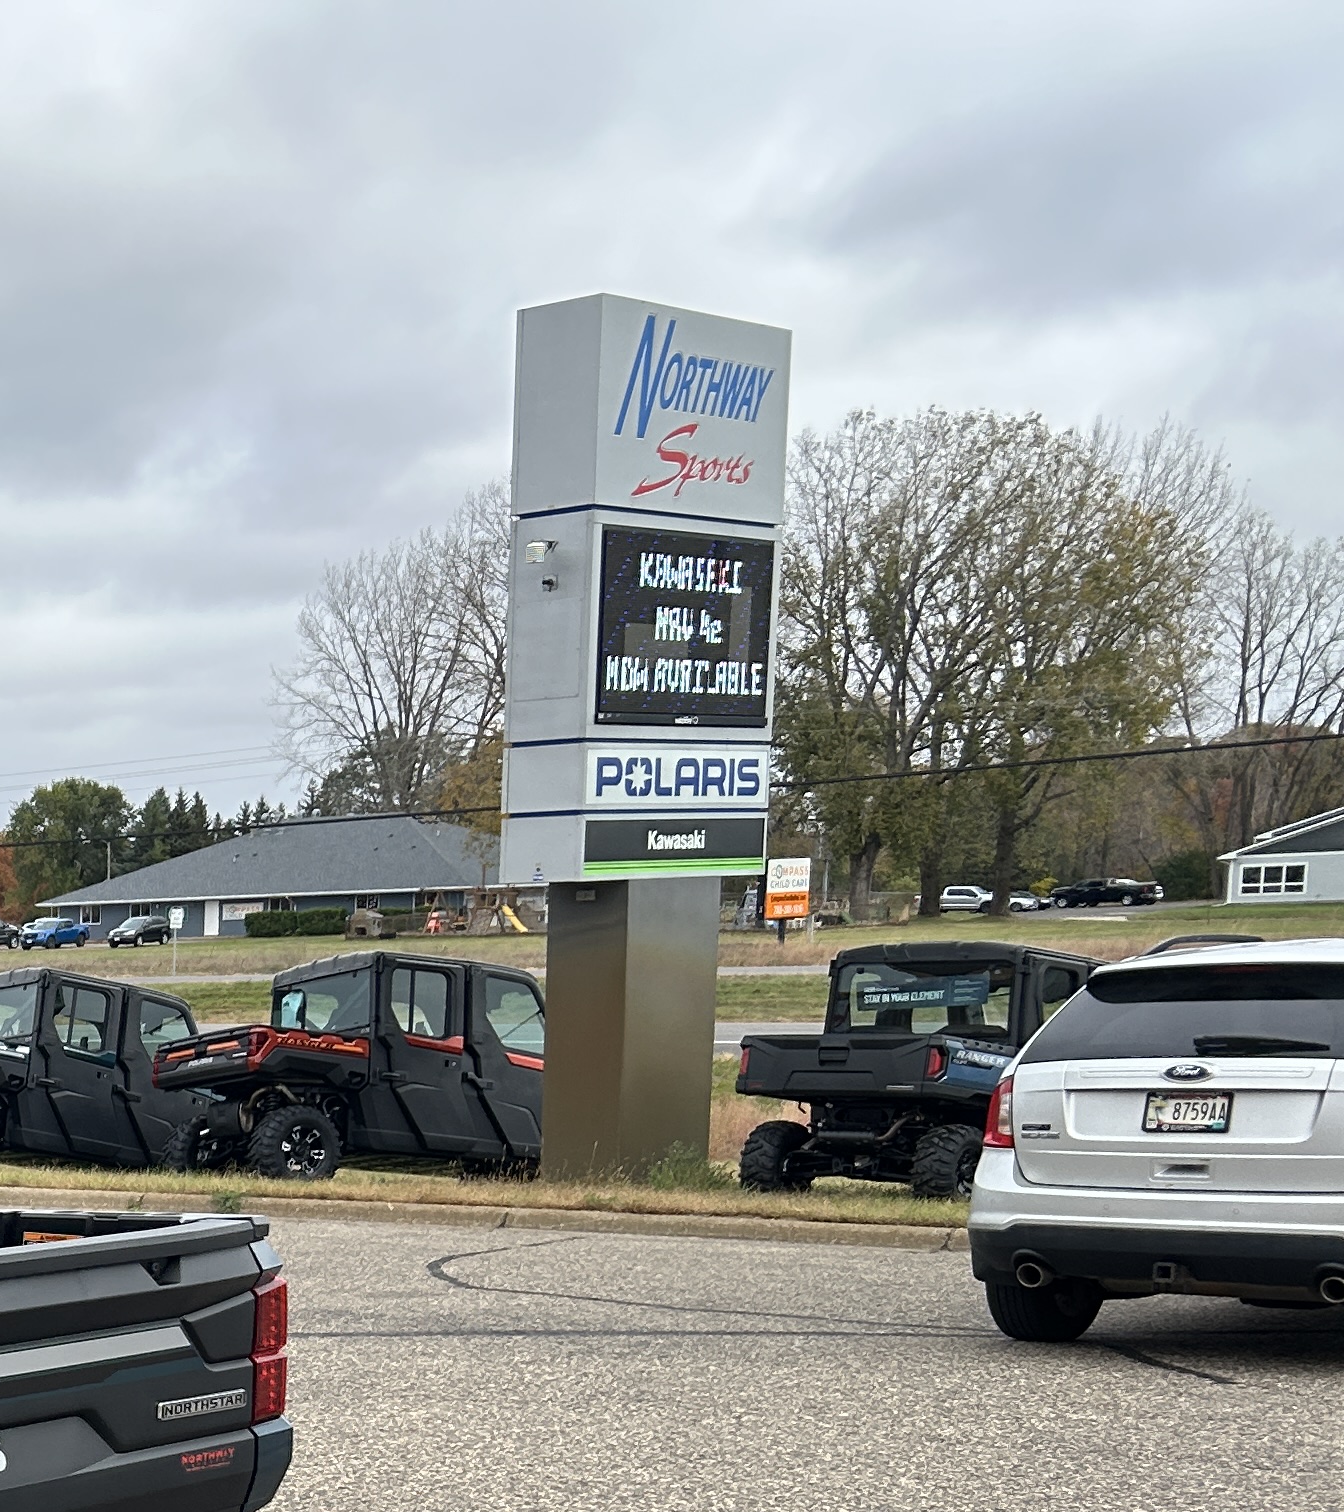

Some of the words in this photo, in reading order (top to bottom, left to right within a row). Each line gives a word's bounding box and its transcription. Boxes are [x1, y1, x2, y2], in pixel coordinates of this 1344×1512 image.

[631, 423, 754, 496] Sports
[605, 655, 649, 692] NOW
[653, 658, 763, 696] AVAILABLE
[595, 757, 760, 797] POLARIS
[647, 829, 706, 851] Kawasaki
[956, 1050, 1005, 1066] RANGER
[1173, 1102, 1226, 1121] 8759AA
[162, 1393, 244, 1418] NORTHSTAR
